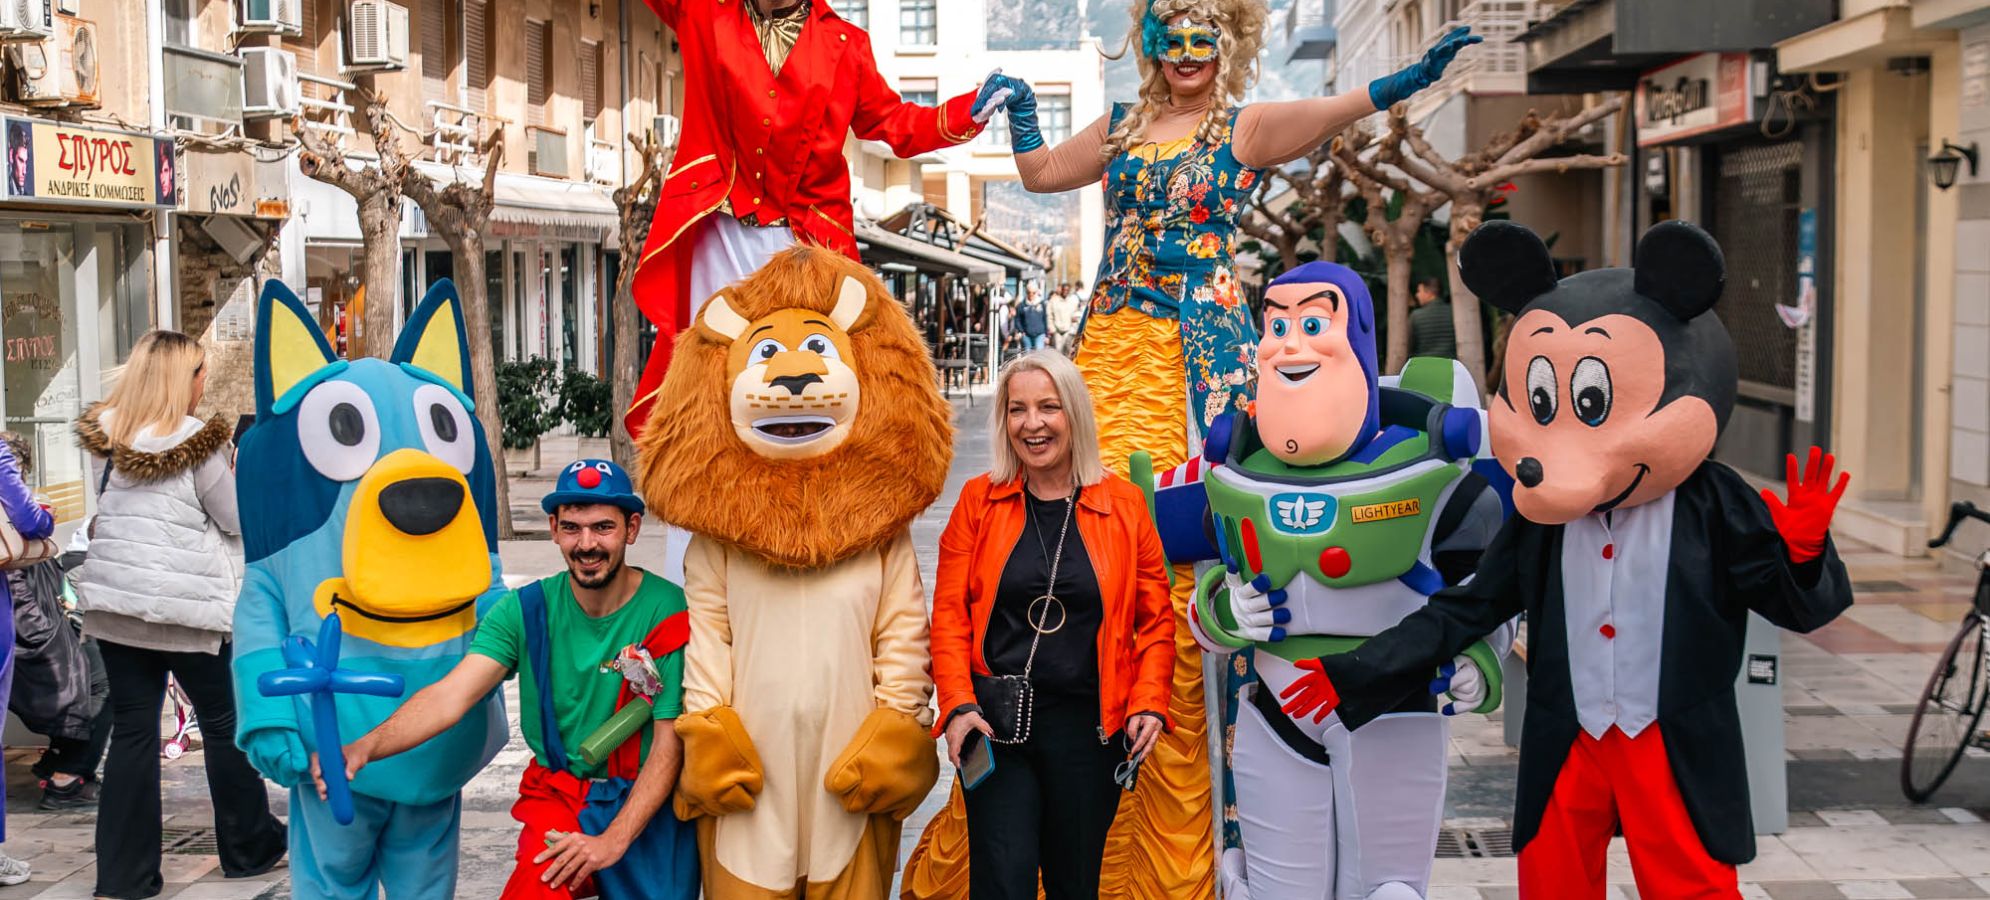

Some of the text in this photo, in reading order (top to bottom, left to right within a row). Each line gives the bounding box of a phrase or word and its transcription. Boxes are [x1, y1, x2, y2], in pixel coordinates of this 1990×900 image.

[56, 132, 136, 180] ΣΠΥΡΟΣ
[48, 180, 145, 201] ΑΝΔΡΙΚΕΣ ΚΟΜΜΩΣΕΙΣ
[1354, 500, 1419, 520] LIGHTYEAR
